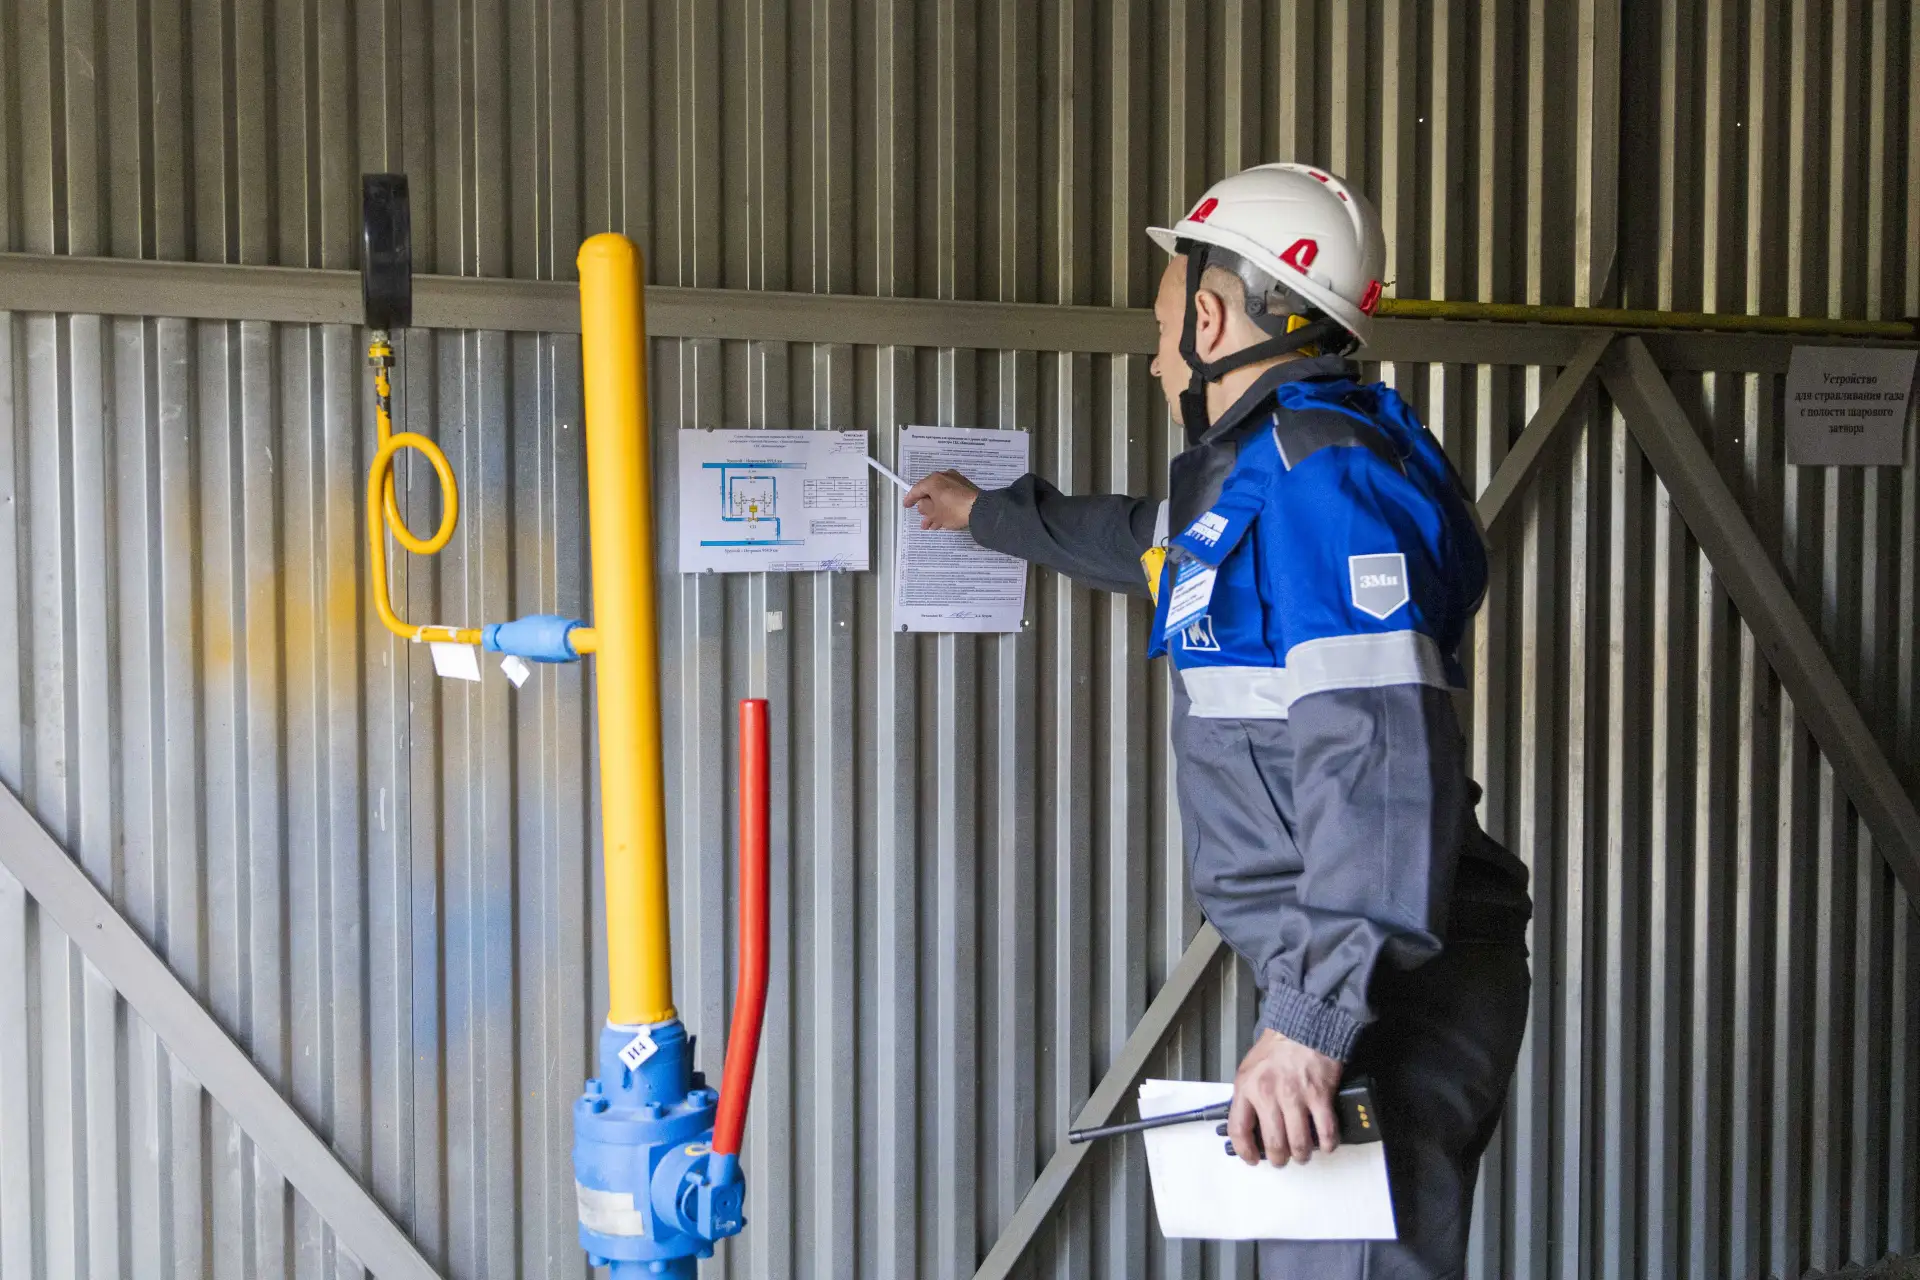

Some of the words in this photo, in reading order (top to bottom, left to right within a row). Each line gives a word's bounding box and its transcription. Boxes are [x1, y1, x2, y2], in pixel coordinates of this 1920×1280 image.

[1823, 373, 1877, 386] Устройство
[1795, 392, 1812, 401] для
[1814, 392, 1881, 403] стравливания
[1884, 392, 1905, 401] газа
[1800, 408, 1806, 417] с
[1807, 408, 1846, 417] полости
[1848, 408, 1894, 419] шарового
[1829, 425, 1864, 435] затвора
